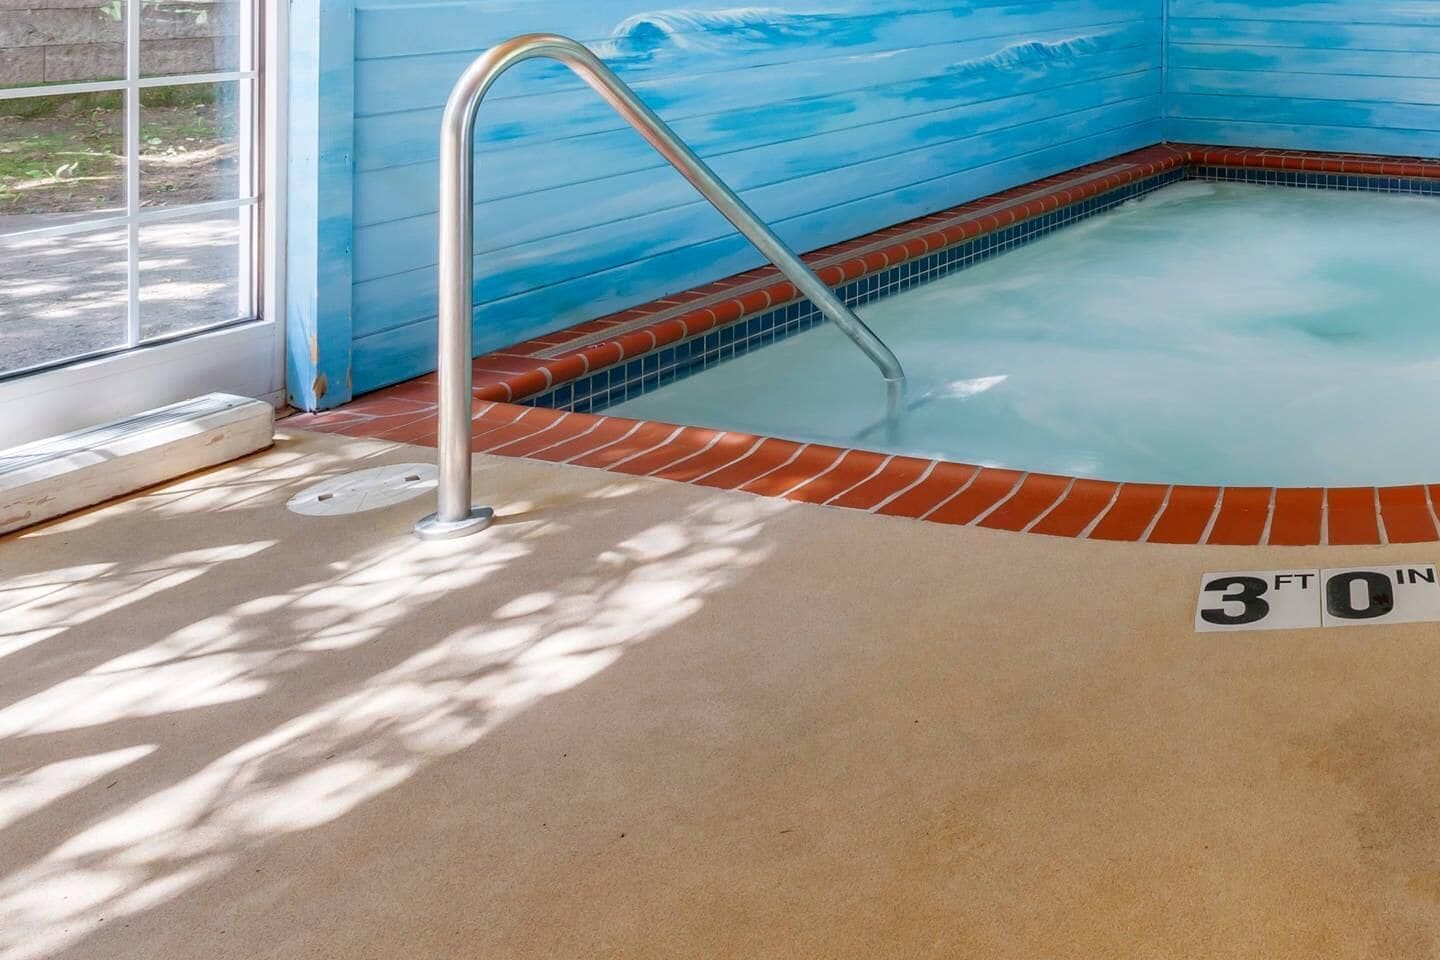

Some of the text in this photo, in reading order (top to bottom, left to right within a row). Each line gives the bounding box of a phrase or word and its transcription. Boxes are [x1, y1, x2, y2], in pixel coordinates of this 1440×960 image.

[1201, 568, 1435, 625] 3 FT 0 IN
